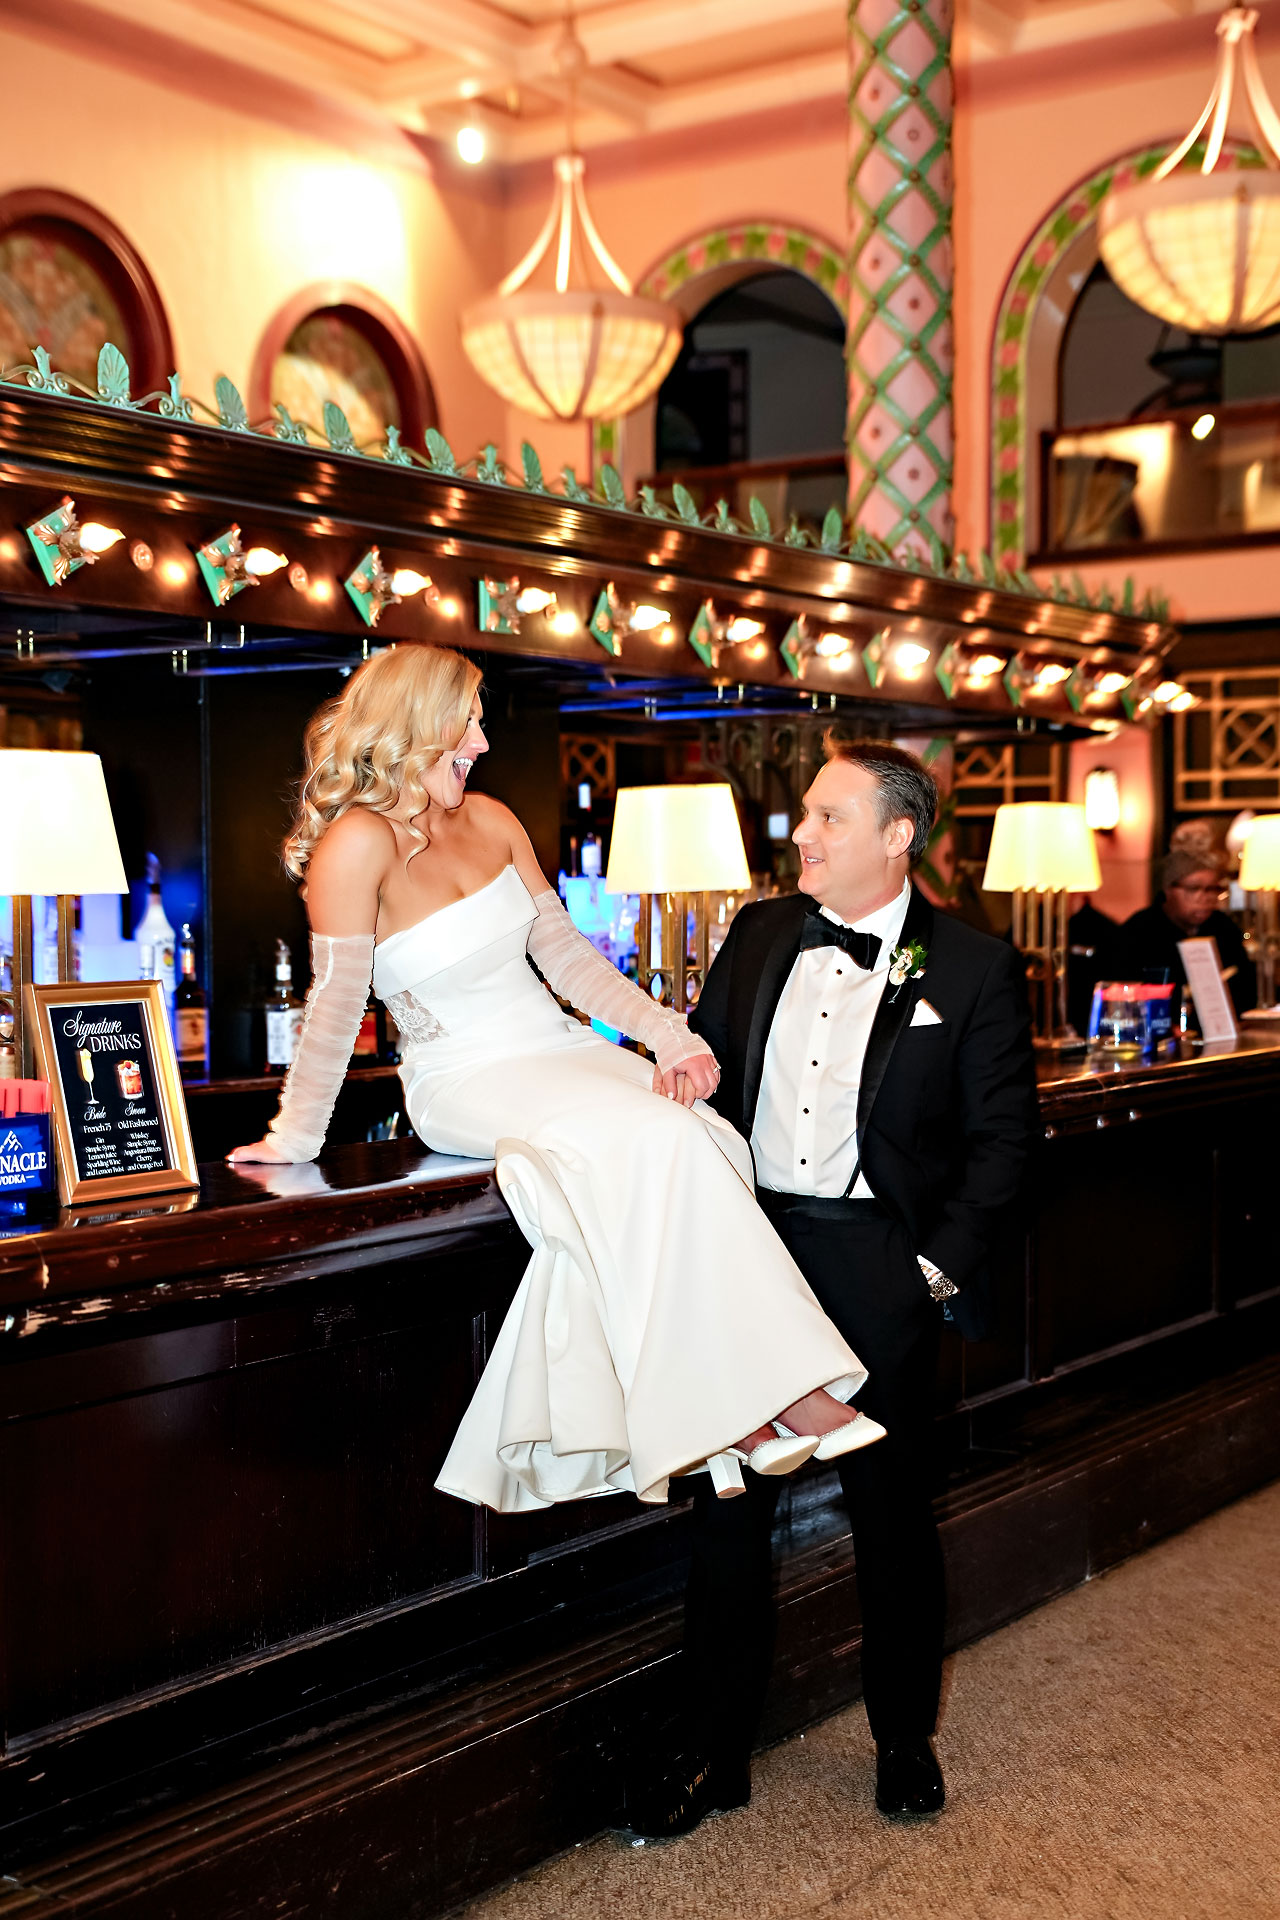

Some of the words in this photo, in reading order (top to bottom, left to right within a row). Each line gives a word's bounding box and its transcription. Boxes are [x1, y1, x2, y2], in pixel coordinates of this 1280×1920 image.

[63, 1010, 122, 1048] Signature
[90, 1033, 142, 1052] DRINKS
[84, 1106, 107, 1121] Bride
[118, 1120, 129, 1129] Old
[129, 1117, 159, 1128] Fashioned
[83, 1123, 105, 1133] French
[127, 1140, 143, 1148] Simple
[142, 1139, 157, 1147] Syrup
[85, 1145, 102, 1153] Simple
[136, 1154, 153, 1162] Cherry
[127, 1163, 137, 1171] and
[85, 1169, 96, 1177] and
